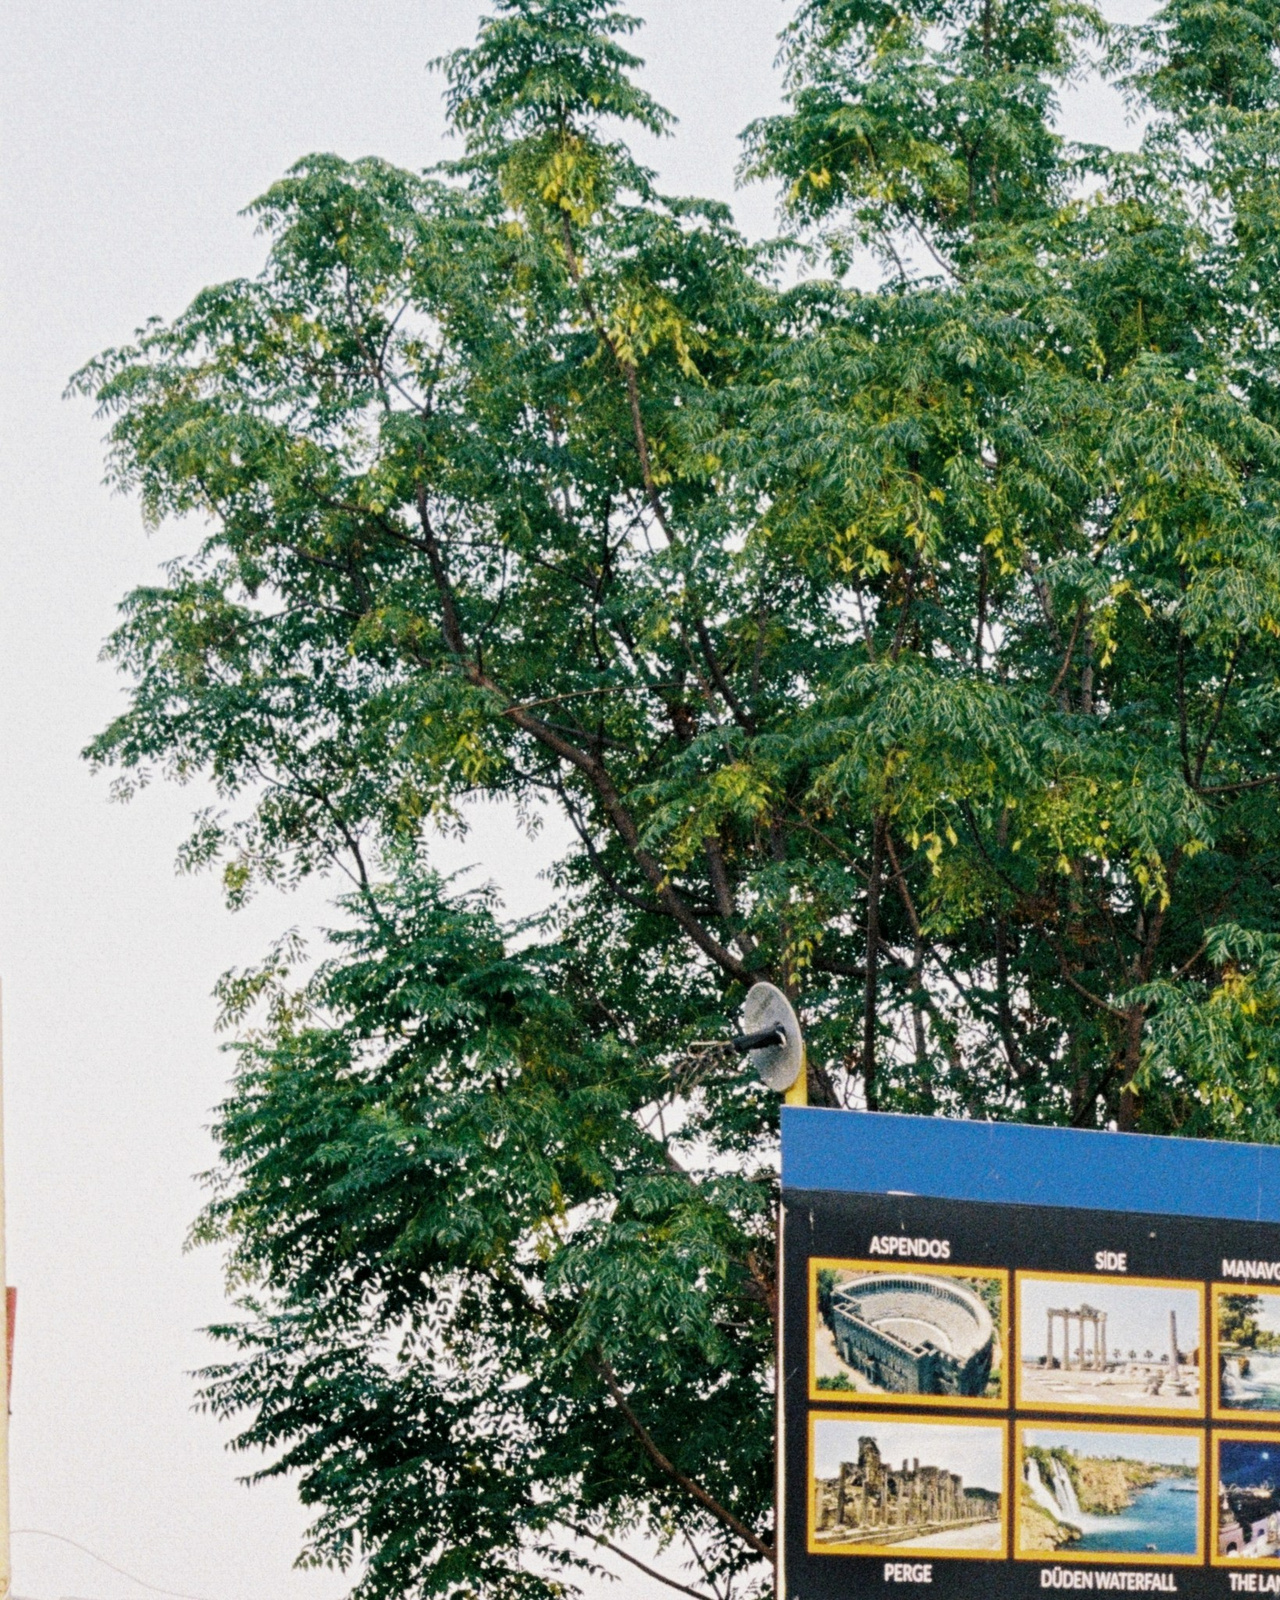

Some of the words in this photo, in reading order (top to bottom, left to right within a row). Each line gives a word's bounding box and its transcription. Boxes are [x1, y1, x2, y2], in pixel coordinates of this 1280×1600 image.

[869, 1235, 950, 1259] ASPENDOS
[884, 1563, 933, 1584] PERGE
[1040, 1567, 1095, 1589] DÜDEN
[1096, 1571, 1178, 1592] WATERFALL
[1229, 1573, 1257, 1592] THE
